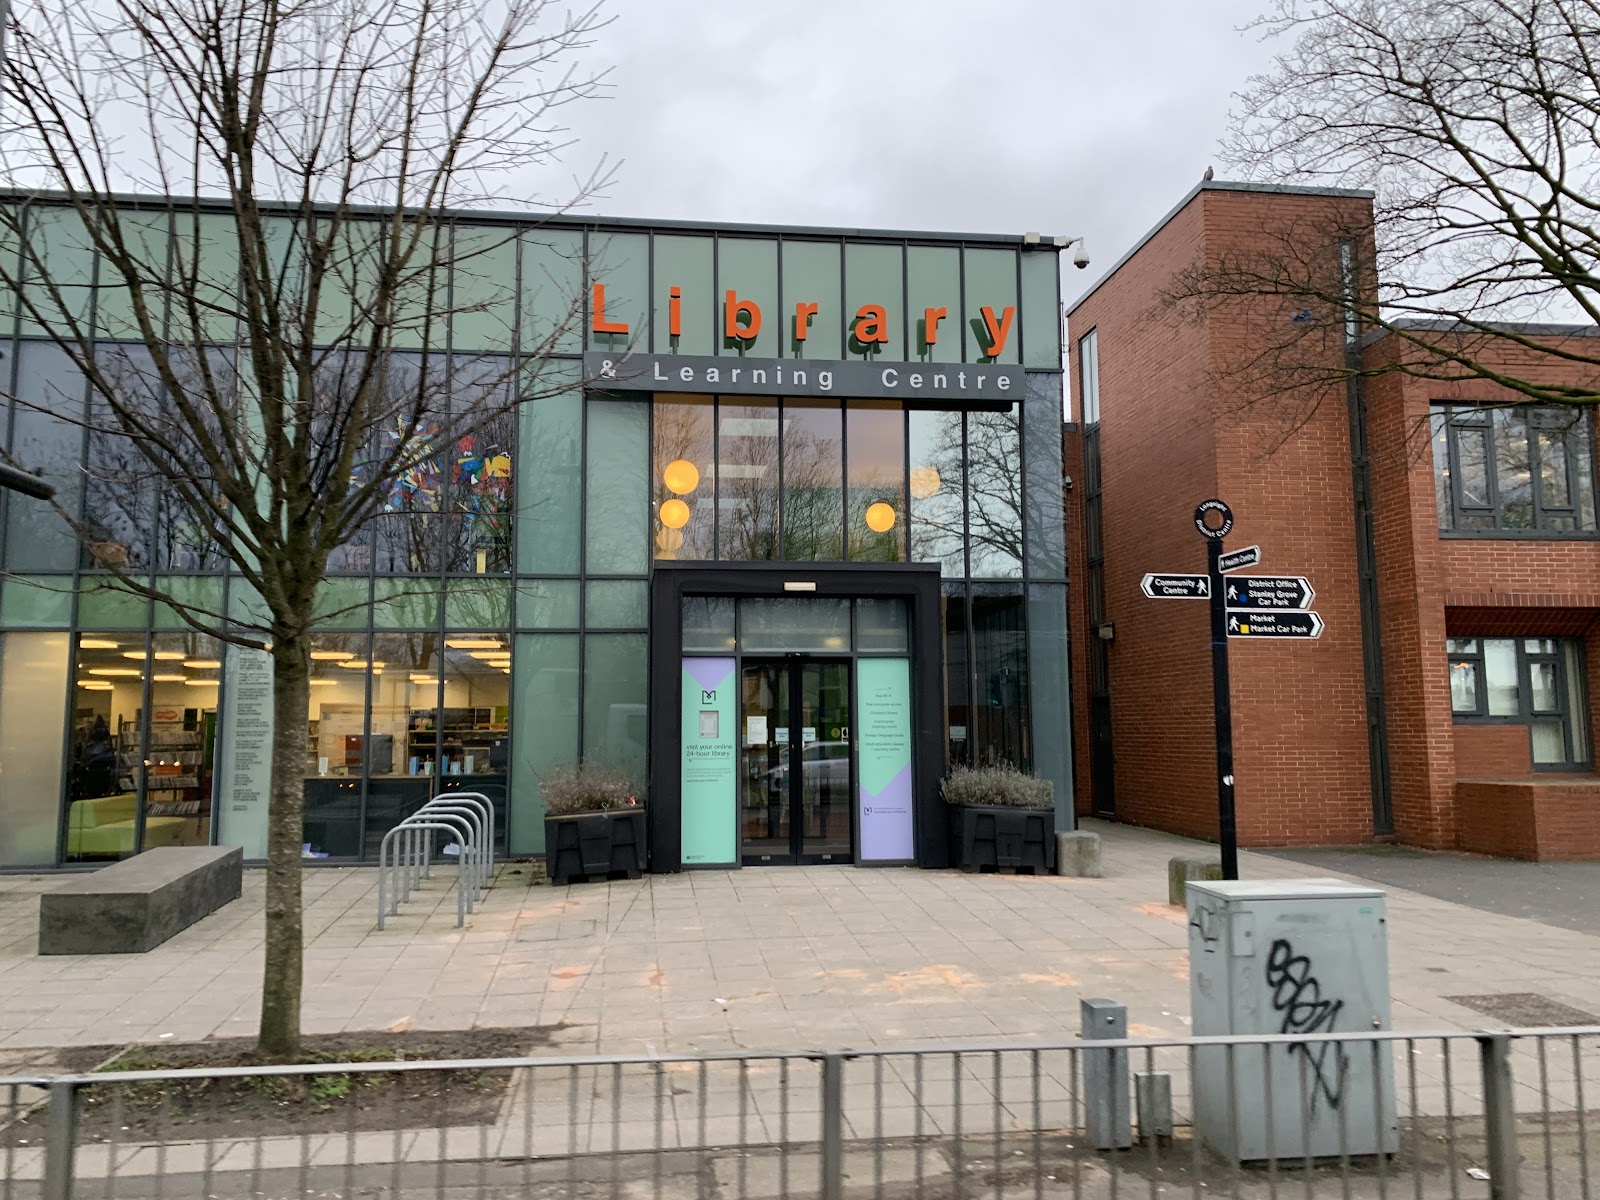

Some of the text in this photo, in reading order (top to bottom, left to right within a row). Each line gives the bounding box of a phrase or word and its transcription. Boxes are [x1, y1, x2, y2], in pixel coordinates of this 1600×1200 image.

[592, 284, 1016, 358] Library
[600, 359, 1011, 391] & Learning Centre
[1154, 578, 1196, 588] Community
[1248, 580, 1298, 588] District Office
[1162, 587, 1189, 595] Centre
[1248, 590, 1298, 599] Stanley Grove
[1258, 598, 1290, 606] Car Park
[1250, 614, 1276, 623] Market
[1250, 624, 1308, 633] Market Car Park
